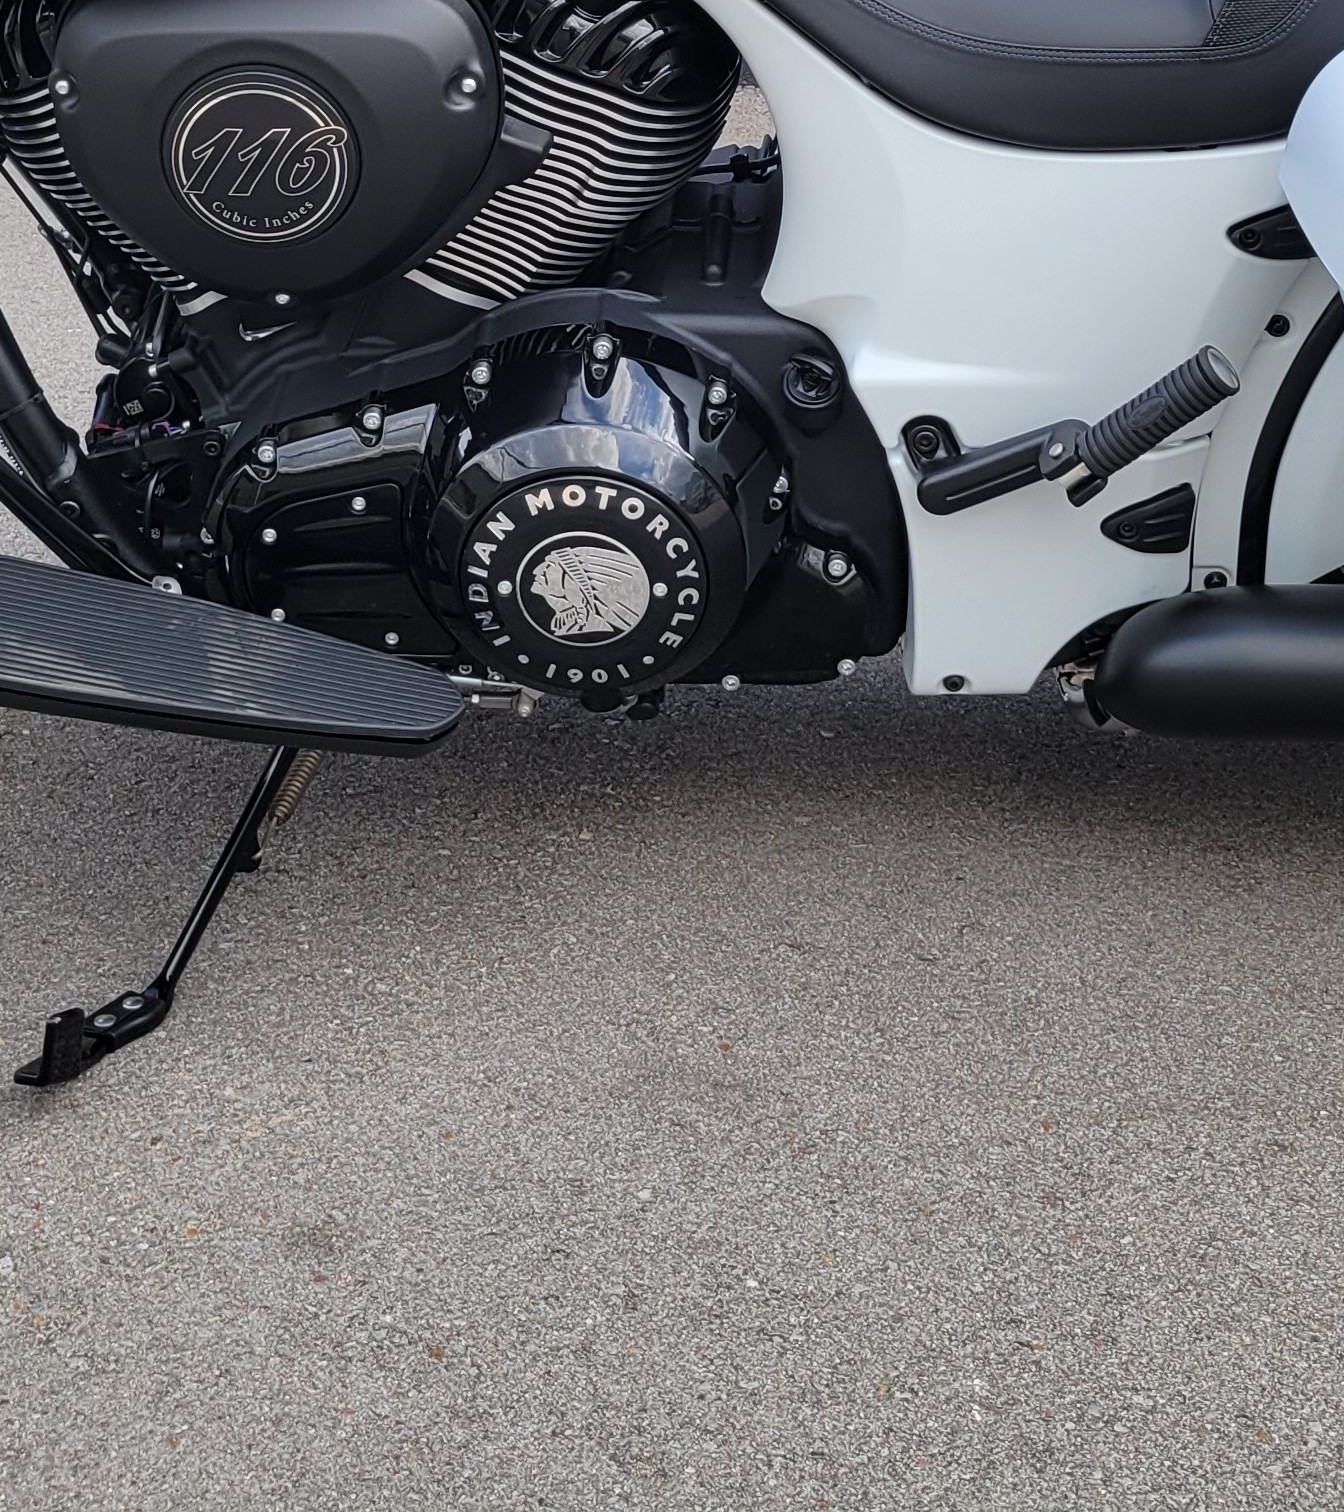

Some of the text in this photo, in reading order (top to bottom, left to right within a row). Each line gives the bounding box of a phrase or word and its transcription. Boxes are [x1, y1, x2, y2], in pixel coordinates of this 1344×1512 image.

[183, 125, 348, 197] 116
[212, 200, 314, 228] Cubic Inches
[467, 484, 700, 649] INDIAN MOTORCYCLE
[544, 663, 631, 684] 1901
